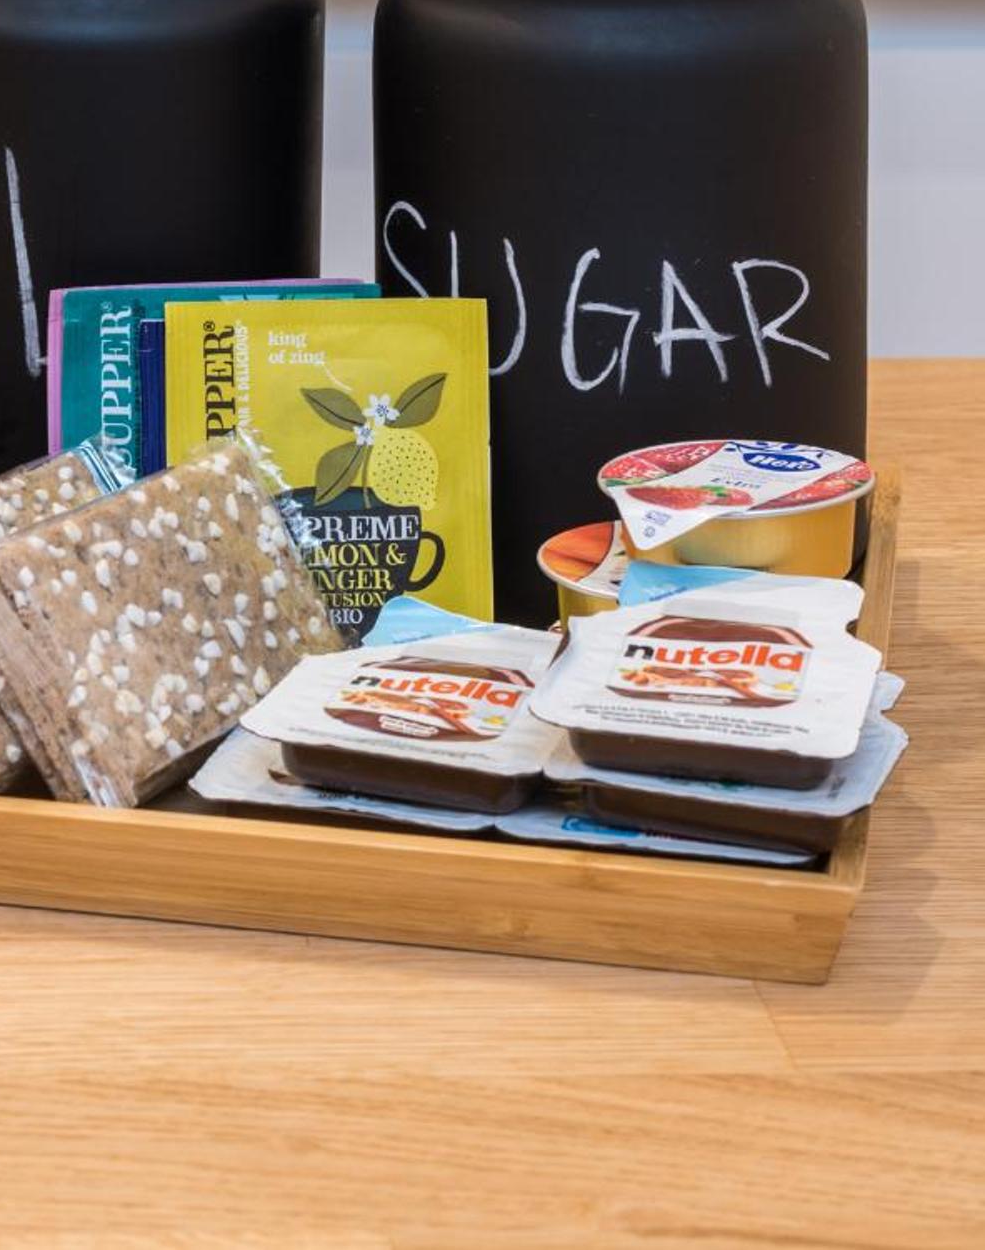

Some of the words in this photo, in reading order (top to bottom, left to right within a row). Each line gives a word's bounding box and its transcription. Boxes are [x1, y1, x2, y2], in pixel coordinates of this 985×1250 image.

[383, 200, 831, 396] SUGAR
[267, 330, 308, 349] king
[267, 348, 287, 365] of
[289, 351, 326, 367] zing
[307, 514, 420, 543] PREME
[308, 543, 381, 567] MON
[385, 542, 407, 566] &
[312, 568, 395, 591] NGER
[321, 591, 387, 608] USION
[329, 607, 364, 625] BIO
[624, 643, 805, 673] nutella
[350, 674, 525, 709] nutella
